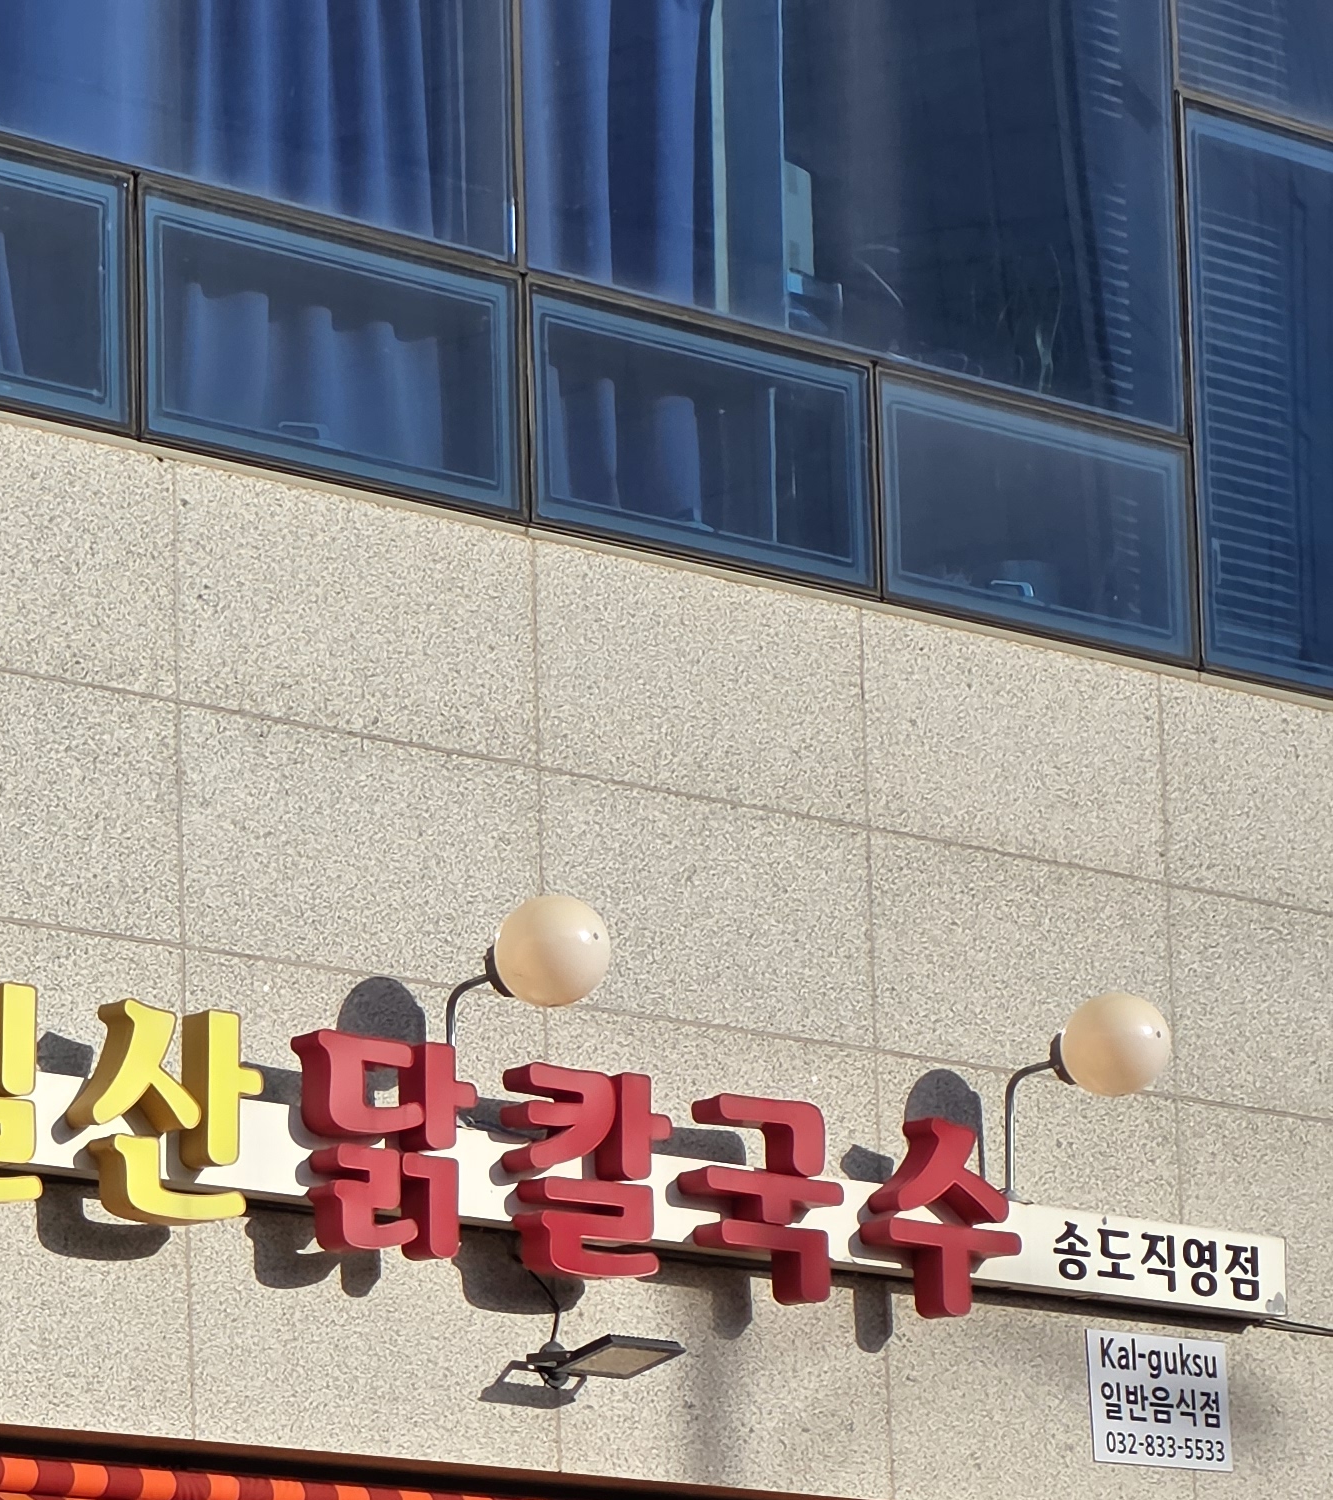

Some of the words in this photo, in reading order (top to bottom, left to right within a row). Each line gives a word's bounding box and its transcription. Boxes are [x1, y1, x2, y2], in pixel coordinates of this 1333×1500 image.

[1053, 1221, 1261, 1302] 송도직영점
[1099, 1336, 1219, 1379] Kal-guksu
[1100, 1382, 1221, 1429] 일반음식점
[1106, 1431, 1226, 1463] 032-833-5533
